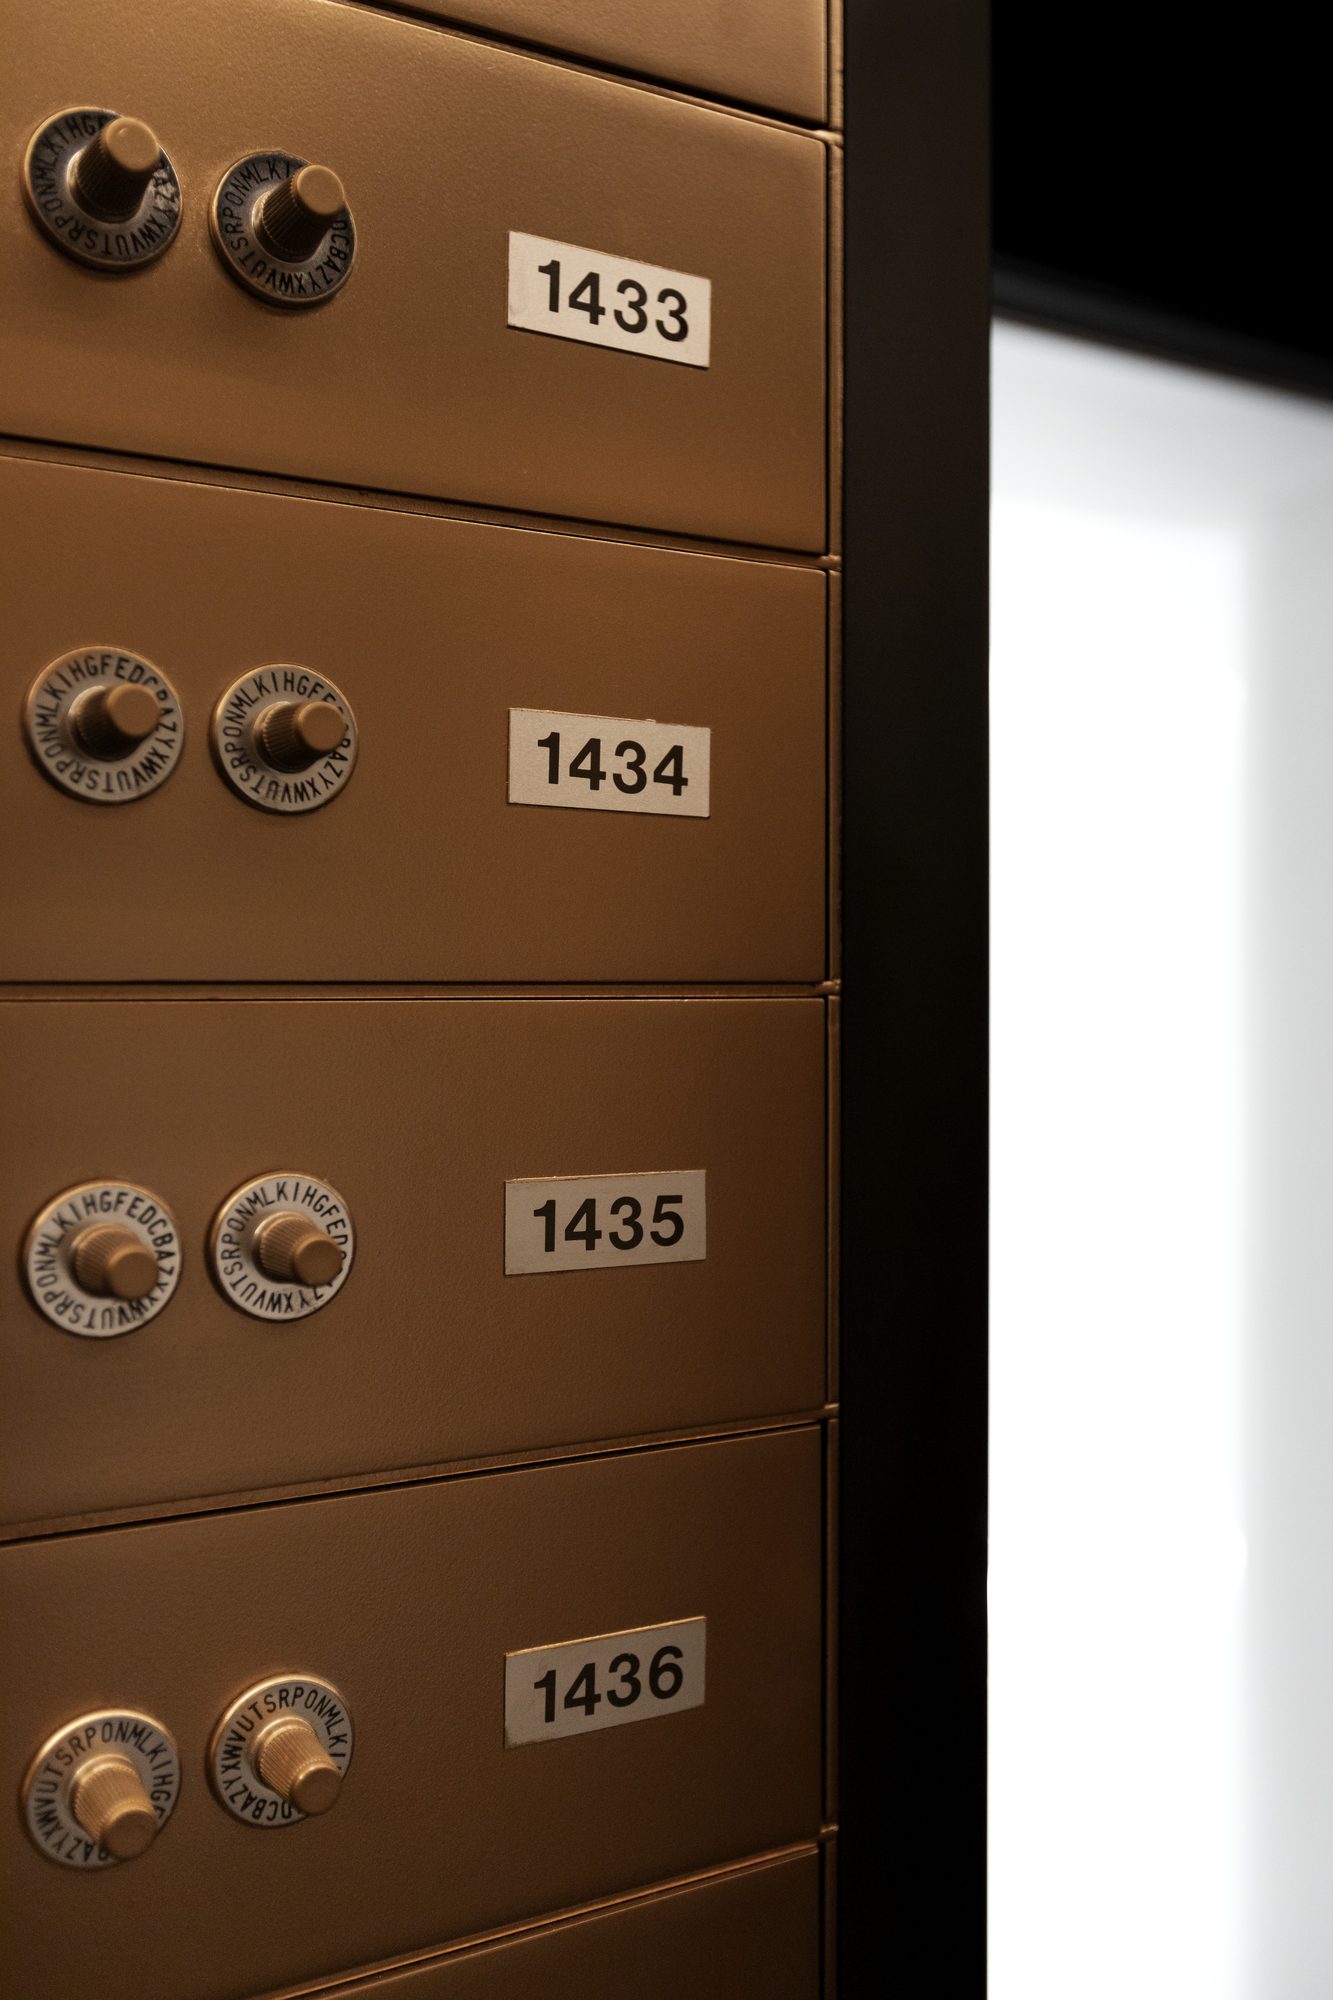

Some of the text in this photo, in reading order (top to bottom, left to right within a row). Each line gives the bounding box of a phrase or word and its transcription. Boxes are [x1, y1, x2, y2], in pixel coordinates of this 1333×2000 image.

[538, 260, 689, 342] 1433
[537, 731, 689, 797] 1434
[533, 1194, 685, 1253] 1435
[533, 1644, 684, 1724] 1436
